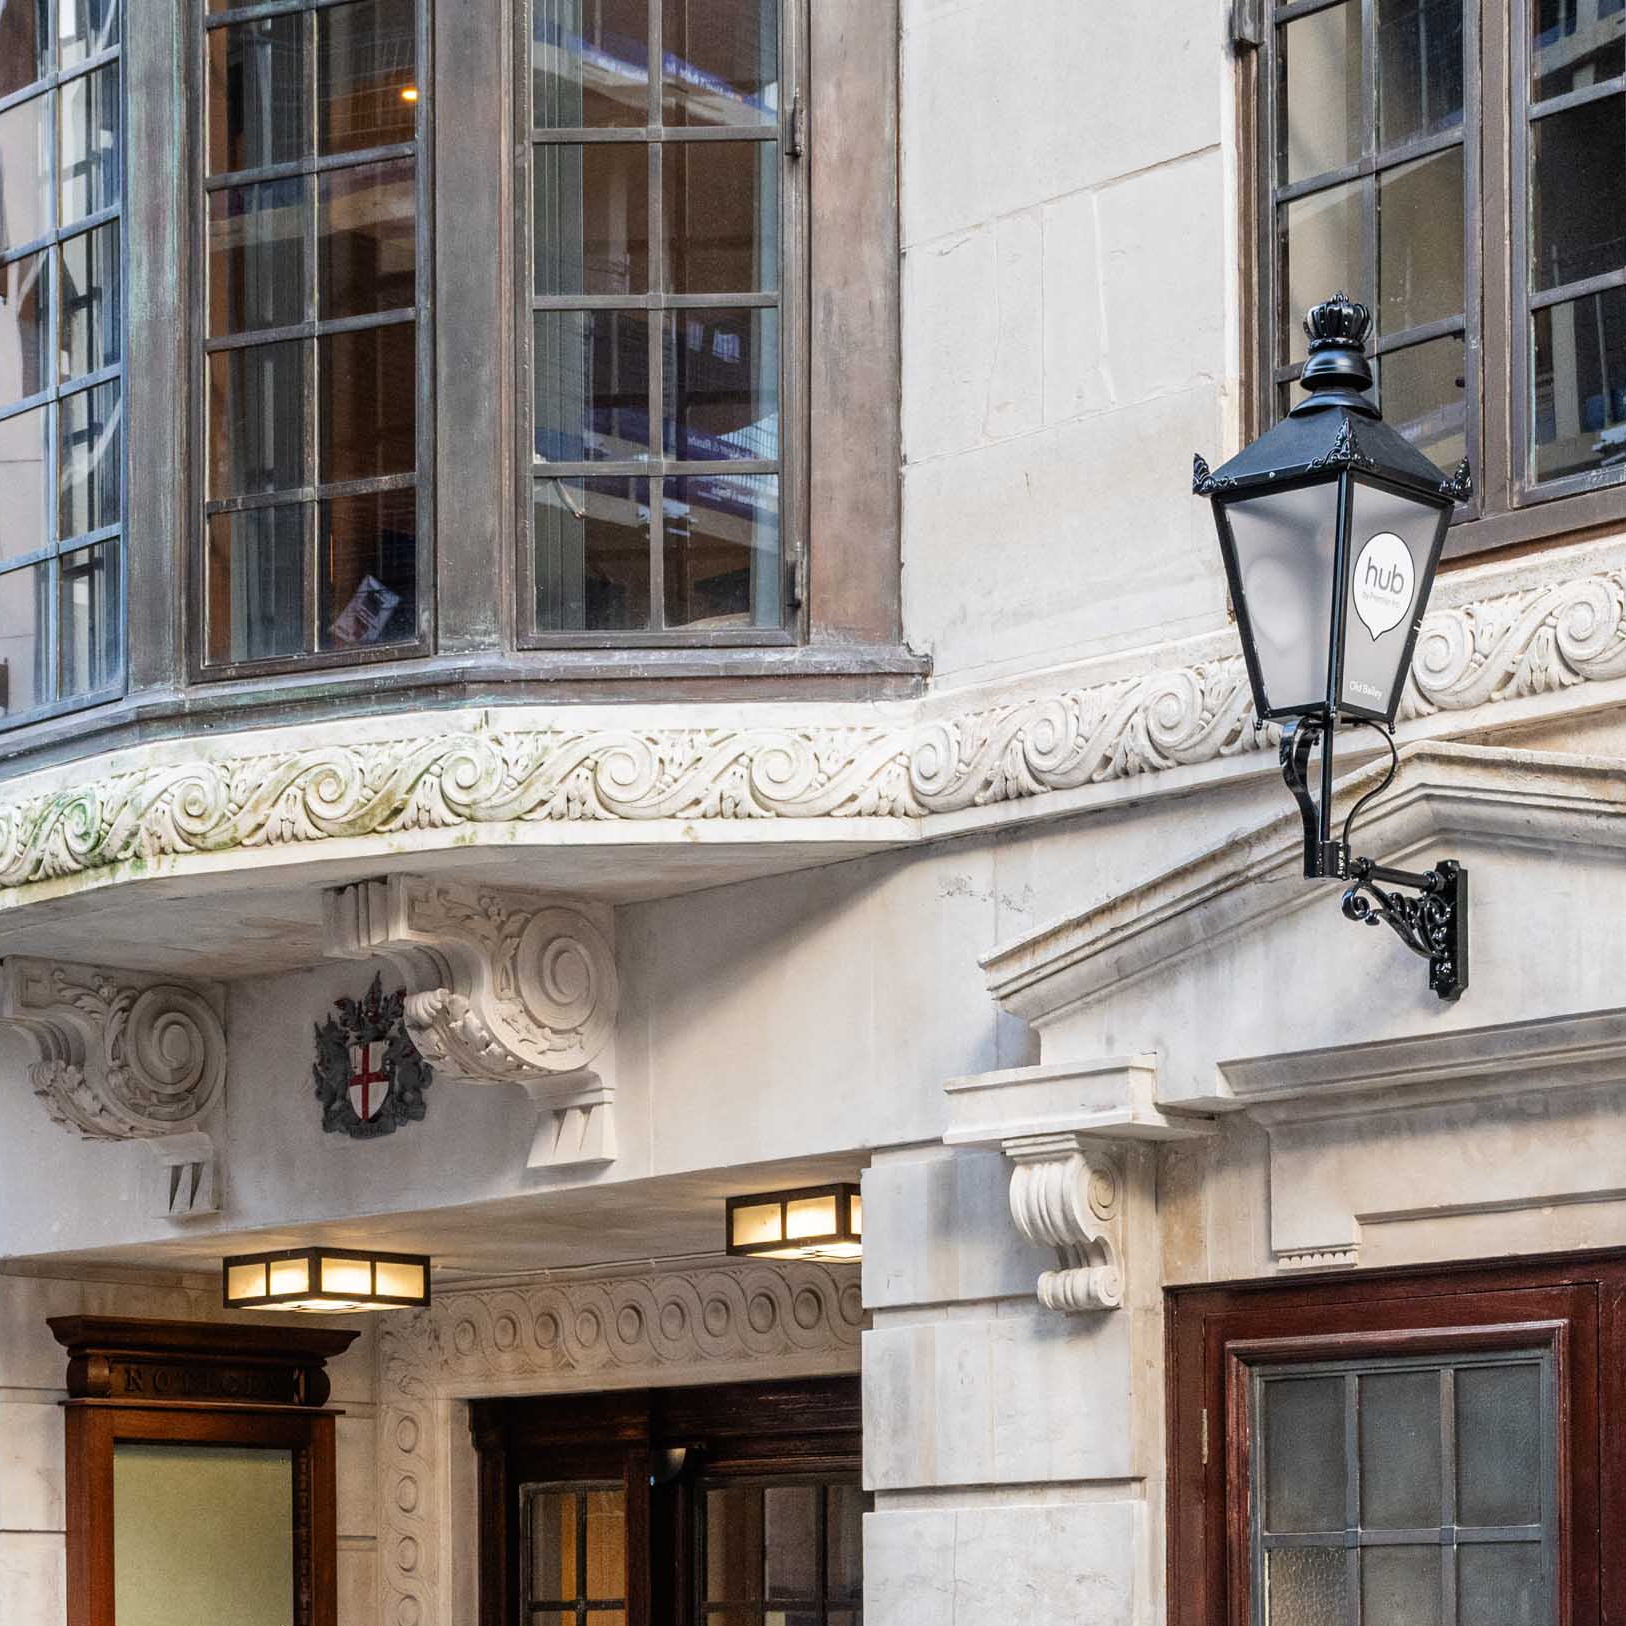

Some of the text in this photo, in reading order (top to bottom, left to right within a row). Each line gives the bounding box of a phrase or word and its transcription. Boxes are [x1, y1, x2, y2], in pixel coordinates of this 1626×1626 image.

[1365, 556, 1405, 594] hub
[1349, 680, 1383, 700] Old Bailey
